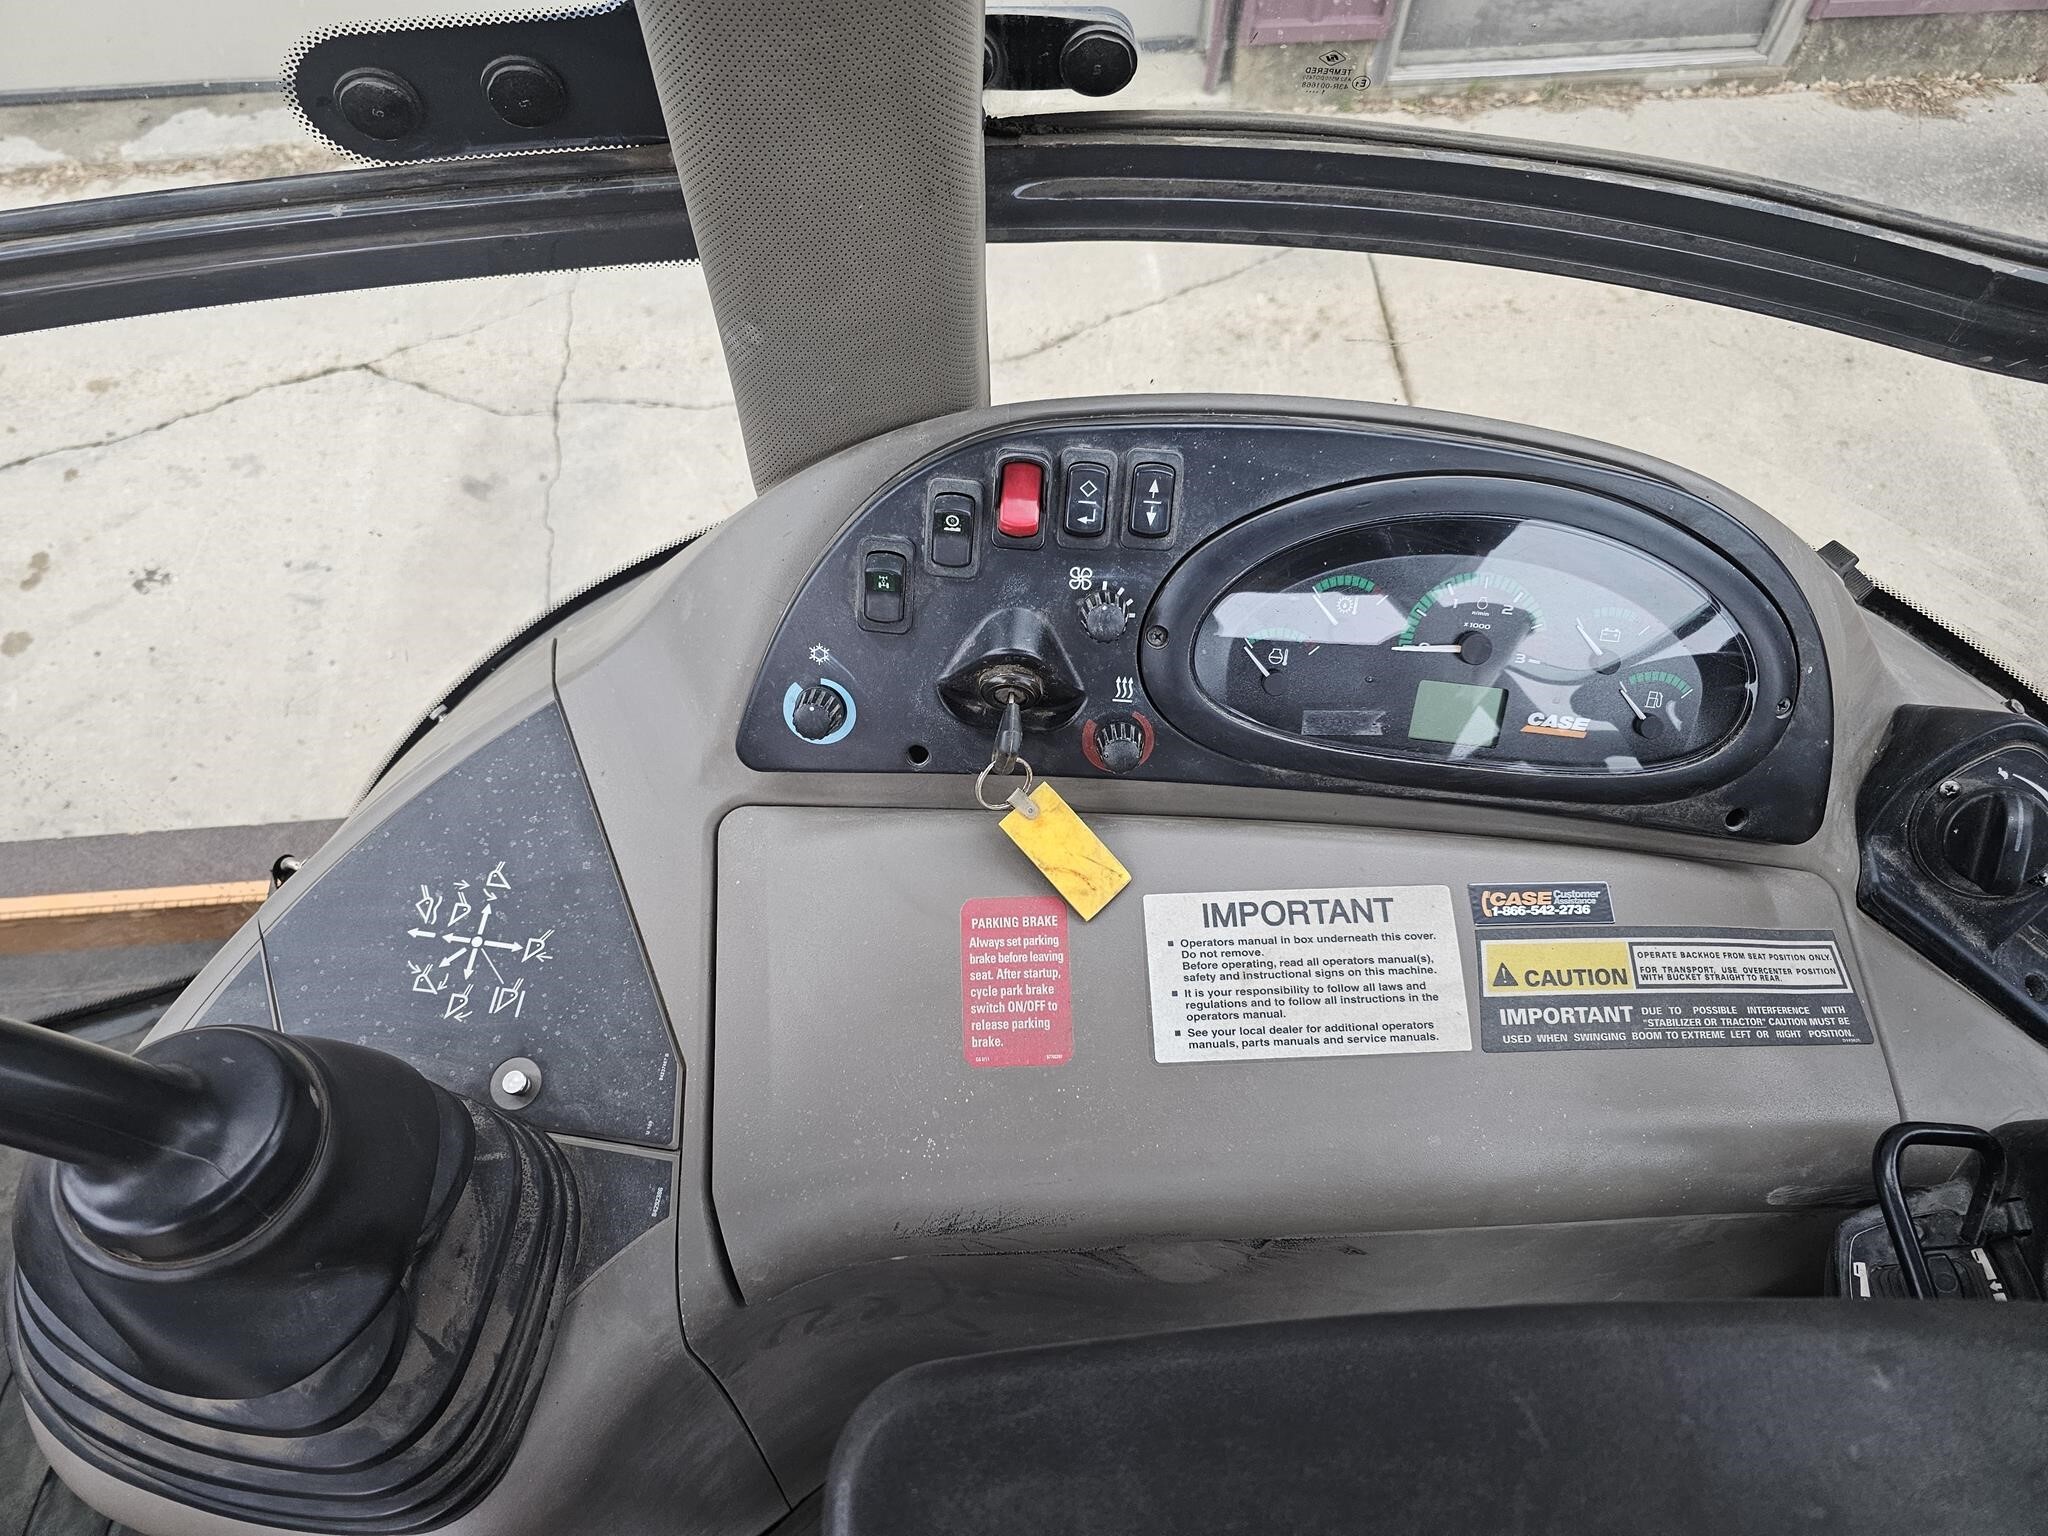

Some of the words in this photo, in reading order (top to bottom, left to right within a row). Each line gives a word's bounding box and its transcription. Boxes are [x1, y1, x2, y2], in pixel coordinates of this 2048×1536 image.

[1452, 599, 1458, 609] 1
[1501, 604, 1515, 615] 2
[1470, 622, 1491, 630] 1000
[1514, 653, 1526, 664] 3
[1527, 712, 1591, 732] CASE
[1489, 890, 1552, 906] CASE
[1553, 890, 1600, 899] Customer
[1553, 897, 1596, 905] Assistance
[1202, 897, 1394, 928] IMPORTANT
[1491, 904, 1591, 917] 1-866-542-2736
[971, 916, 1019, 929] PARKING
[1022, 915, 1058, 928] BRAKE
[969, 936, 1005, 950] Always
[1006, 936, 1022, 946] set
[1023, 934, 1060, 949] parking
[1180, 937, 1235, 949] Operators
[1238, 936, 1278, 946] manual
[1281, 935, 1291, 944] in
[1294, 935, 1313, 944] box
[1317, 933, 1378, 943] underneath
[1381, 932, 1401, 941] this
[1404, 932, 1437, 941] cover.
[969, 952, 997, 965] brake
[998, 951, 1028, 964] before
[1029, 950, 1064, 964] leaving
[1181, 950, 1196, 959] Do
[1199, 949, 1217, 958] not
[1221, 949, 1265, 957] remove.
[1637, 951, 1677, 960] OPERATE
[1680, 951, 1720, 960] BACKHOE
[1723, 952, 1745, 960] FROM
[1747, 952, 1767, 961] SEAT
[1769, 953, 1806, 961] POSITION
[1808, 953, 1833, 962] ONLY.
[1182, 961, 1218, 970] Before
[1221, 959, 1277, 970] operating,
[1279, 958, 1304, 967] read
[1306, 957, 1319, 966] all
[1322, 956, 1375, 967] operators
[1377, 954, 1435, 965] manual(s),
[969, 969, 994, 981] seat.
[996, 968, 1021, 980] After
[1023, 968, 1061, 981] startup,
[1183, 972, 1216, 983] safety
[1219, 971, 1240, 980] and
[1243, 969, 1312, 980] instructional
[1314, 967, 1345, 979] signs
[1347, 968, 1362, 977] on
[1364, 967, 1385, 976] this
[1388, 965, 1437, 975] machine.
[1524, 968, 1629, 987] CAUTION
[1639, 966, 1659, 974] FOR
[1662, 966, 1716, 975] TRANSPORT,
[1721, 966, 1738, 974] USE
[1742, 967, 1793, 975] OVERCENTER
[1796, 967, 1836, 975] POSITION
[1640, 973, 1664, 981] WITH
[1667, 973, 1701, 981] BUCKET
[1704, 974, 1744, 982] STRAIGHT
[1746, 974, 1757, 982] TO
[1760, 974, 1783, 983] REAR.
[970, 985, 998, 1000] cycle
[1000, 984, 1023, 999] park
[1026, 983, 1055, 996] brake
[1184, 989, 1192, 998] It
[1194, 988, 1205, 998] is
[1207, 989, 1232, 999] your
[1236, 985, 1310, 997] responsibility
[1313, 985, 1324, 994] to
[1327, 983, 1360, 993] follow
[1362, 982, 1375, 992] all
[1378, 982, 1403, 991] laws
[1406, 981, 1427, 990] and
[970, 1002, 1005, 1015] switch
[1007, 1000, 1046, 1013] ON/OFF
[1047, 1001, 1058, 1012] to
[1185, 1000, 1248, 1011] regulations
[1250, 998, 1271, 1007] and
[1274, 998, 1286, 1006] to
[1288, 996, 1321, 1006] follow
[1324, 996, 1338, 1005] all
[1340, 994, 1406, 1004] instructions
[1408, 993, 1419, 1002] in
[1421, 992, 1439, 1001] the
[1186, 1012, 1239, 1023] operators
[1242, 1010, 1286, 1019] manual.
[1500, 1006, 1633, 1025] IMPORTANT
[1641, 1006, 1663, 1015] DUE
[1668, 1006, 1682, 1015] TO
[1693, 1006, 1738, 1015] POSSIBLE
[1747, 1006, 1811, 1015] INTERFERENCE
[1821, 1005, 1846, 1014] WITH
[1643, 1018, 1702, 1027] "STABILIZER
[1703, 1018, 1718, 1027] OR
[1720, 1017, 1767, 1026] TRACTOR"
[1768, 1017, 1808, 1026] CAUTION
[1809, 1017, 1836, 1026] MUST
[1837, 1017, 1850, 1025] BE
[971, 1019, 1009, 1031] release
[1012, 1017, 1051, 1032] parking
[1187, 1028, 1208, 1038] See
[1211, 1029, 1236, 1038] your
[1239, 1026, 1266, 1036] local
[1269, 1025, 1303, 1035] dealer
[1306, 1024, 1321, 1033] for
[1324, 1022, 1379, 1032] additional
[1381, 1021, 1434, 1032] operators
[971, 1036, 1004, 1048] brake.
[1188, 1040, 1239, 1050] manuals,
[1241, 1038, 1270, 1050] parts
[1273, 1036, 1320, 1047] manuals
[1323, 1035, 1344, 1044] and
[1347, 1034, 1387, 1044] service
[1390, 1033, 1439, 1042] manuals.
[1503, 1034, 1532, 1043] USED
[1536, 1033, 1568, 1043] WHEN
[1573, 1032, 1627, 1041] SWINGING
[1632, 1031, 1662, 1041] BOOM
[1665, 1031, 1679, 1040] TO
[1681, 1030, 1726, 1040] EXTREME
[1730, 1030, 1751, 1039] LEFT
[1756, 1030, 1770, 1039] OR
[1776, 1030, 1802, 1039] RIGHT
[1808, 1029, 1855, 1038] POSITION.
